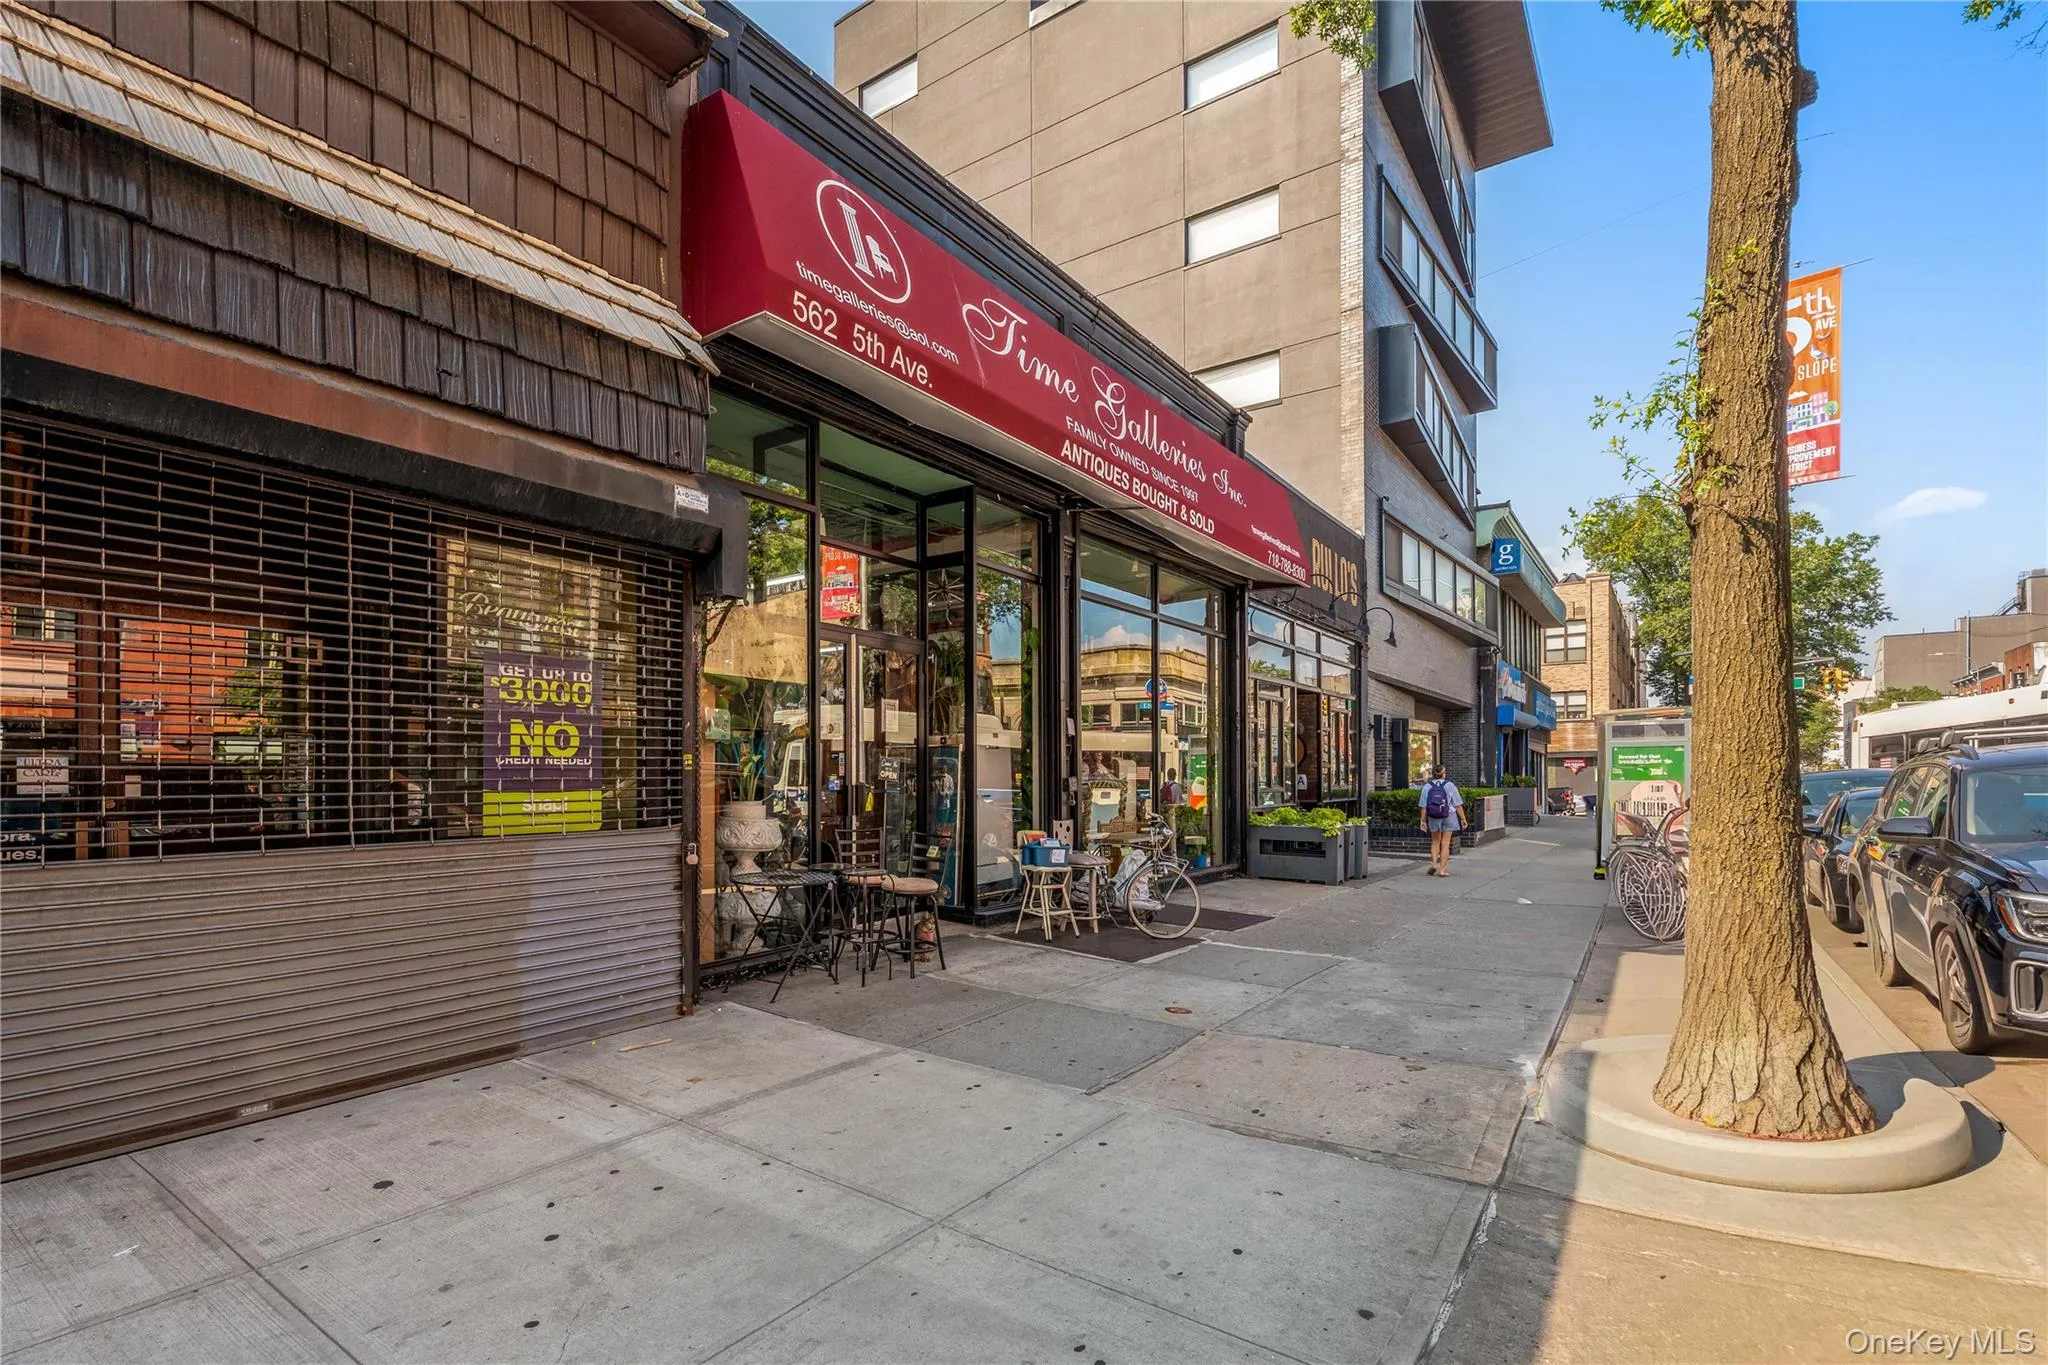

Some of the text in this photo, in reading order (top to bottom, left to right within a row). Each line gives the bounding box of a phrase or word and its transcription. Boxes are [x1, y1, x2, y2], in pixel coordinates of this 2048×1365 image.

[796, 260, 959, 365] timegalleries@aol.com
[1815, 316, 1837, 331] AVE
[792, 290, 934, 389] 562 5th Ave.
[1797, 357, 1838, 381] SLOPE
[961, 297, 1248, 508] Time Galleries Inc.
[1065, 415, 1199, 503] FAMILY OWNED SINCE 1997
[1061, 439, 1215, 535] ANTIQUES BOUGHT & SOLD
[1267, 550, 1307, 582] 718-788-8300
[1498, 543, 1514, 565] g
[843, 601, 861, 614] 562
[509, 718, 580, 758] NO
[880, 770, 897, 780] OPEN
[1297, 776, 1305, 785] A
